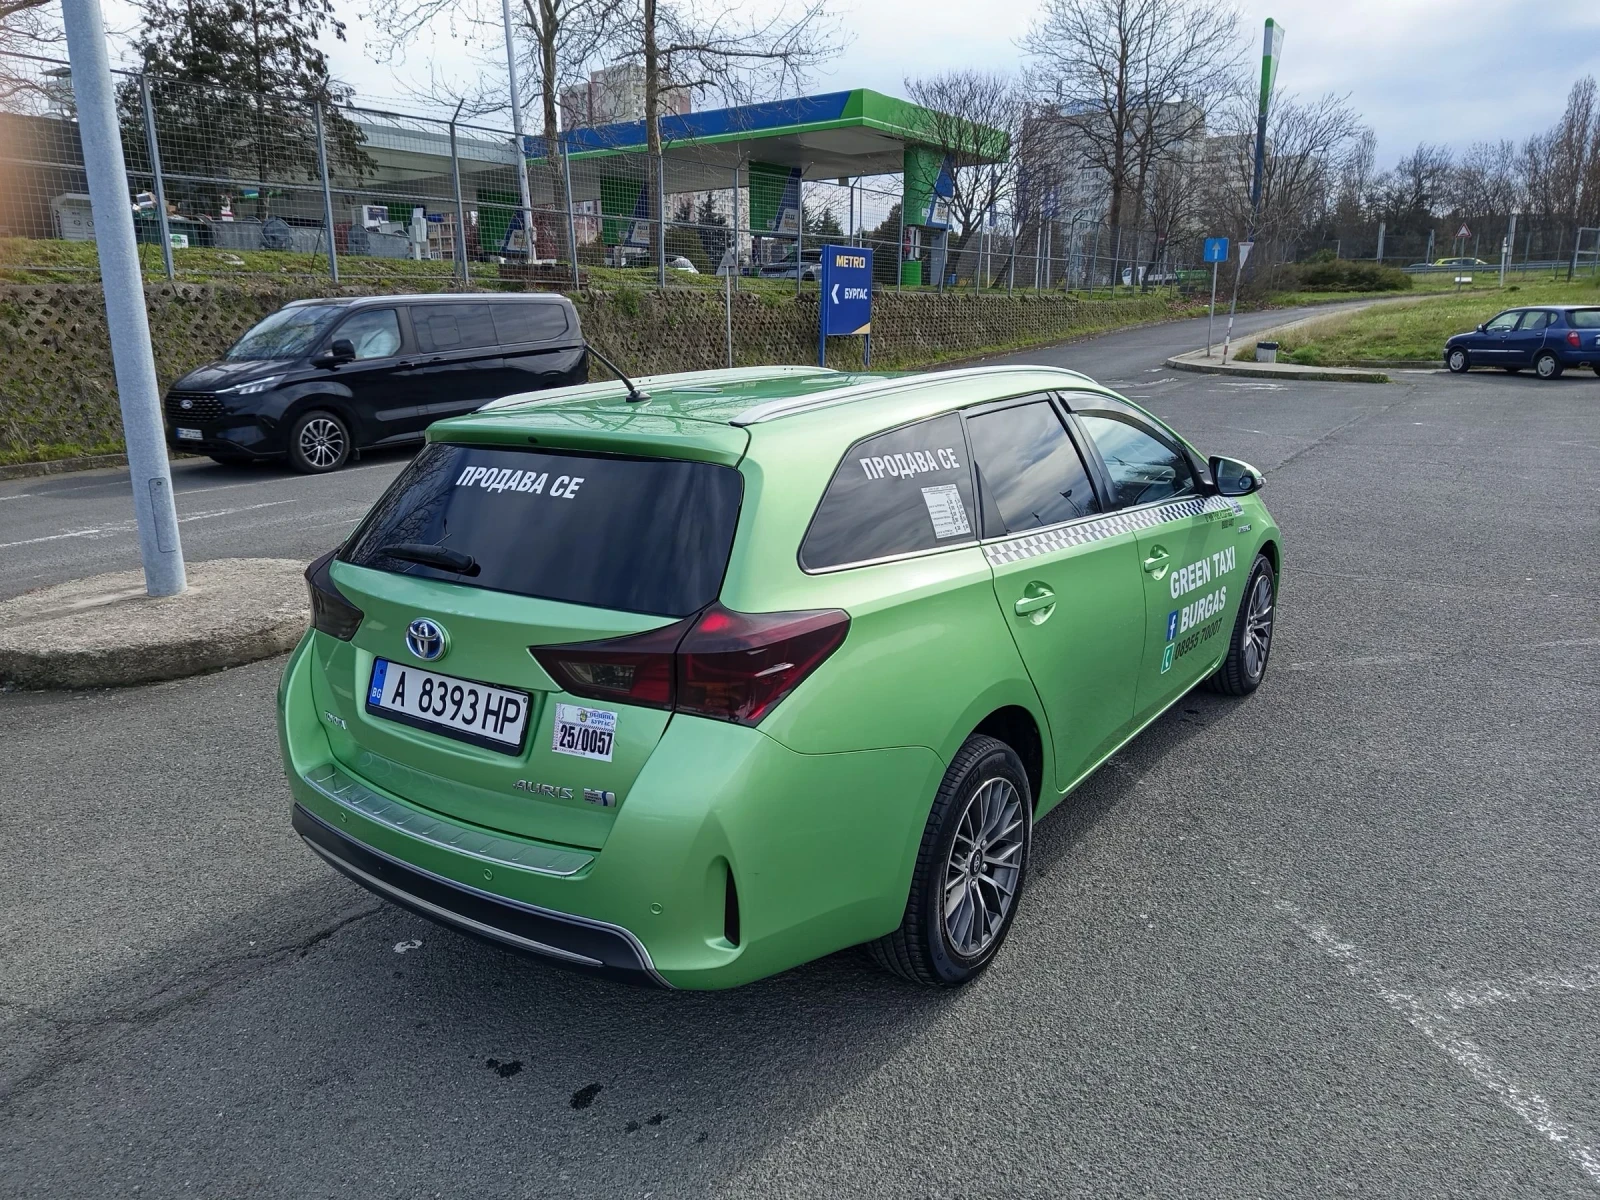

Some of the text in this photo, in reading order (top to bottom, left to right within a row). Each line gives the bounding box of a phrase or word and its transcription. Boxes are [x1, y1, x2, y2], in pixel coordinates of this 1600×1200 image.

[836, 255, 866, 269] METRO
[844, 287, 868, 300] БУРГАС
[859, 448, 960, 480] ПРОДАВА СЕ
[455, 466, 585, 499] ПРОДАВА СЕ
[1170, 545, 1236, 600] GREEN TAXI
[1180, 585, 1227, 634] BURGAS
[1174, 630, 1200, 660] 08955
[371, 687, 382, 698] BG
[391, 671, 406, 707] A
[559, 724, 613, 756] 25/0057
[512, 779, 574, 800] AURIS
